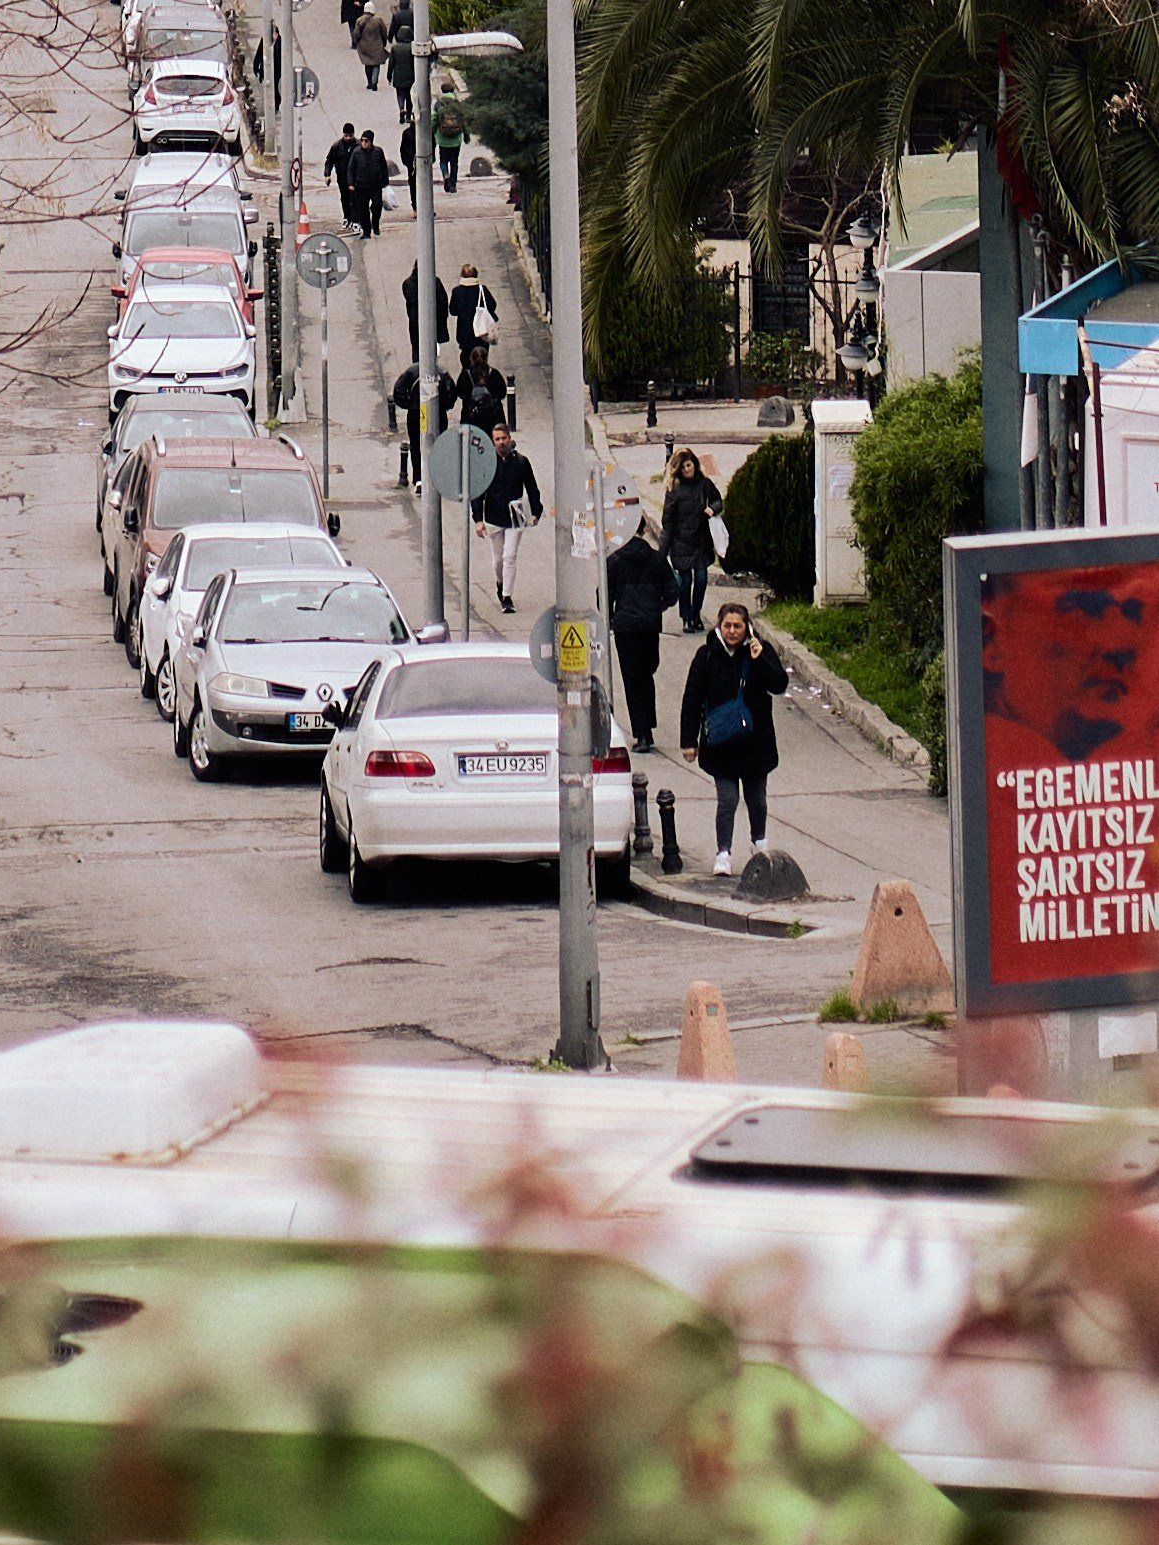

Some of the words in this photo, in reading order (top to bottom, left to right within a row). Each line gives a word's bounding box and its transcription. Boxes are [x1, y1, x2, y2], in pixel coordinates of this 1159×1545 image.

[296, 716, 308, 727] 34
[467, 759, 484, 772] 34
[487, 758, 507, 772] EU
[509, 757, 544, 772] 9235
[1017, 804, 1155, 854] KAYITSIZ
[1017, 849, 1146, 903] ŞARTSIZ
